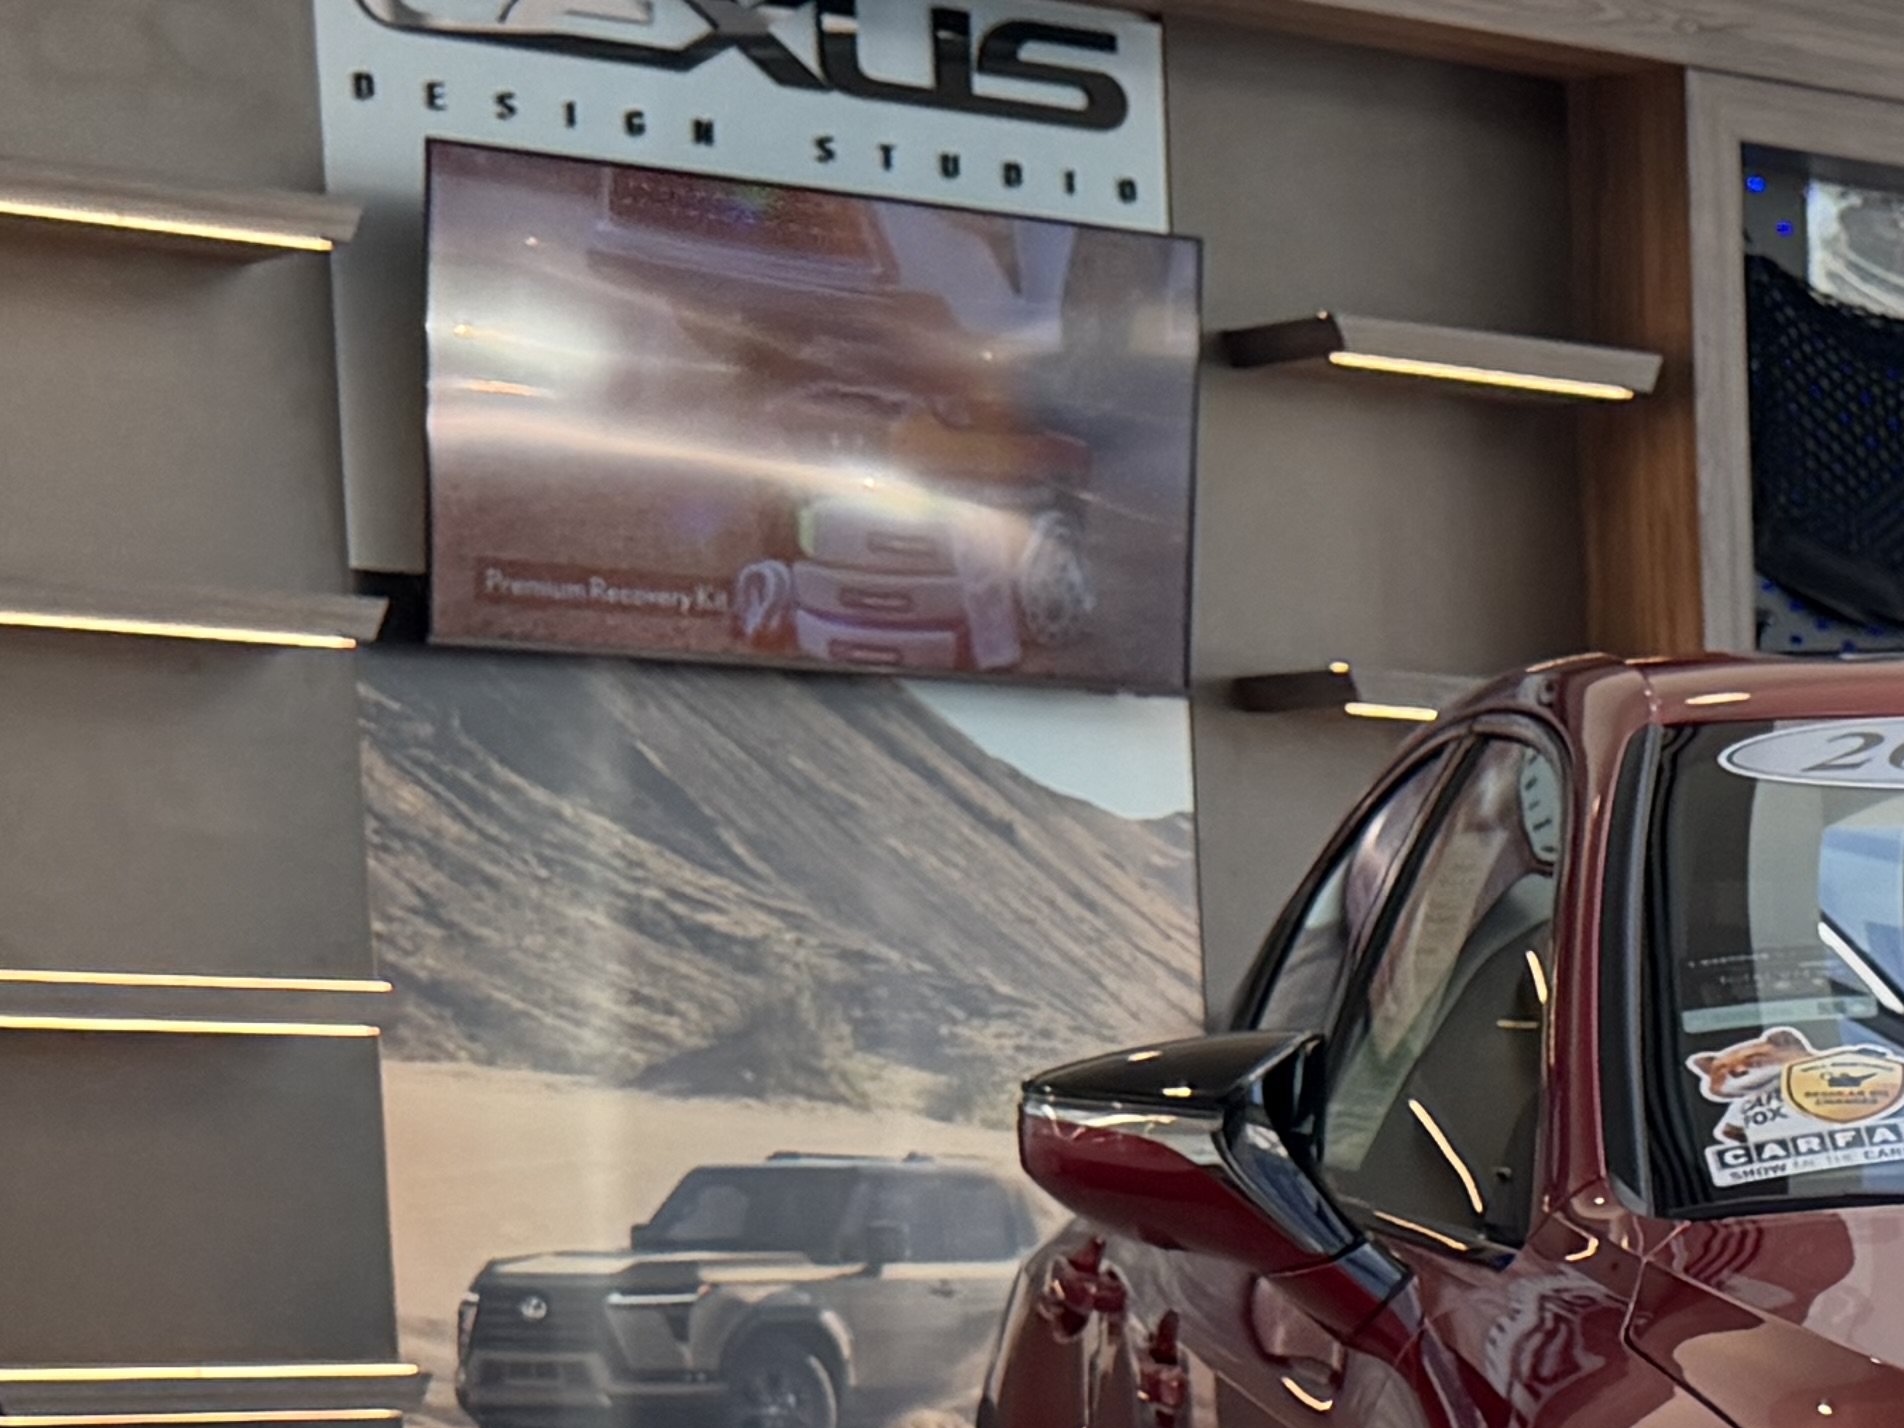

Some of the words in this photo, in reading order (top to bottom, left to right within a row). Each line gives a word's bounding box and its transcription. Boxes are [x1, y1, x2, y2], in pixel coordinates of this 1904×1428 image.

[351, 71, 720, 147] DESIGN
[814, 136, 1139, 206] STUDIO
[484, 567, 587, 600] Premium
[588, 575, 692, 614] Recovery
